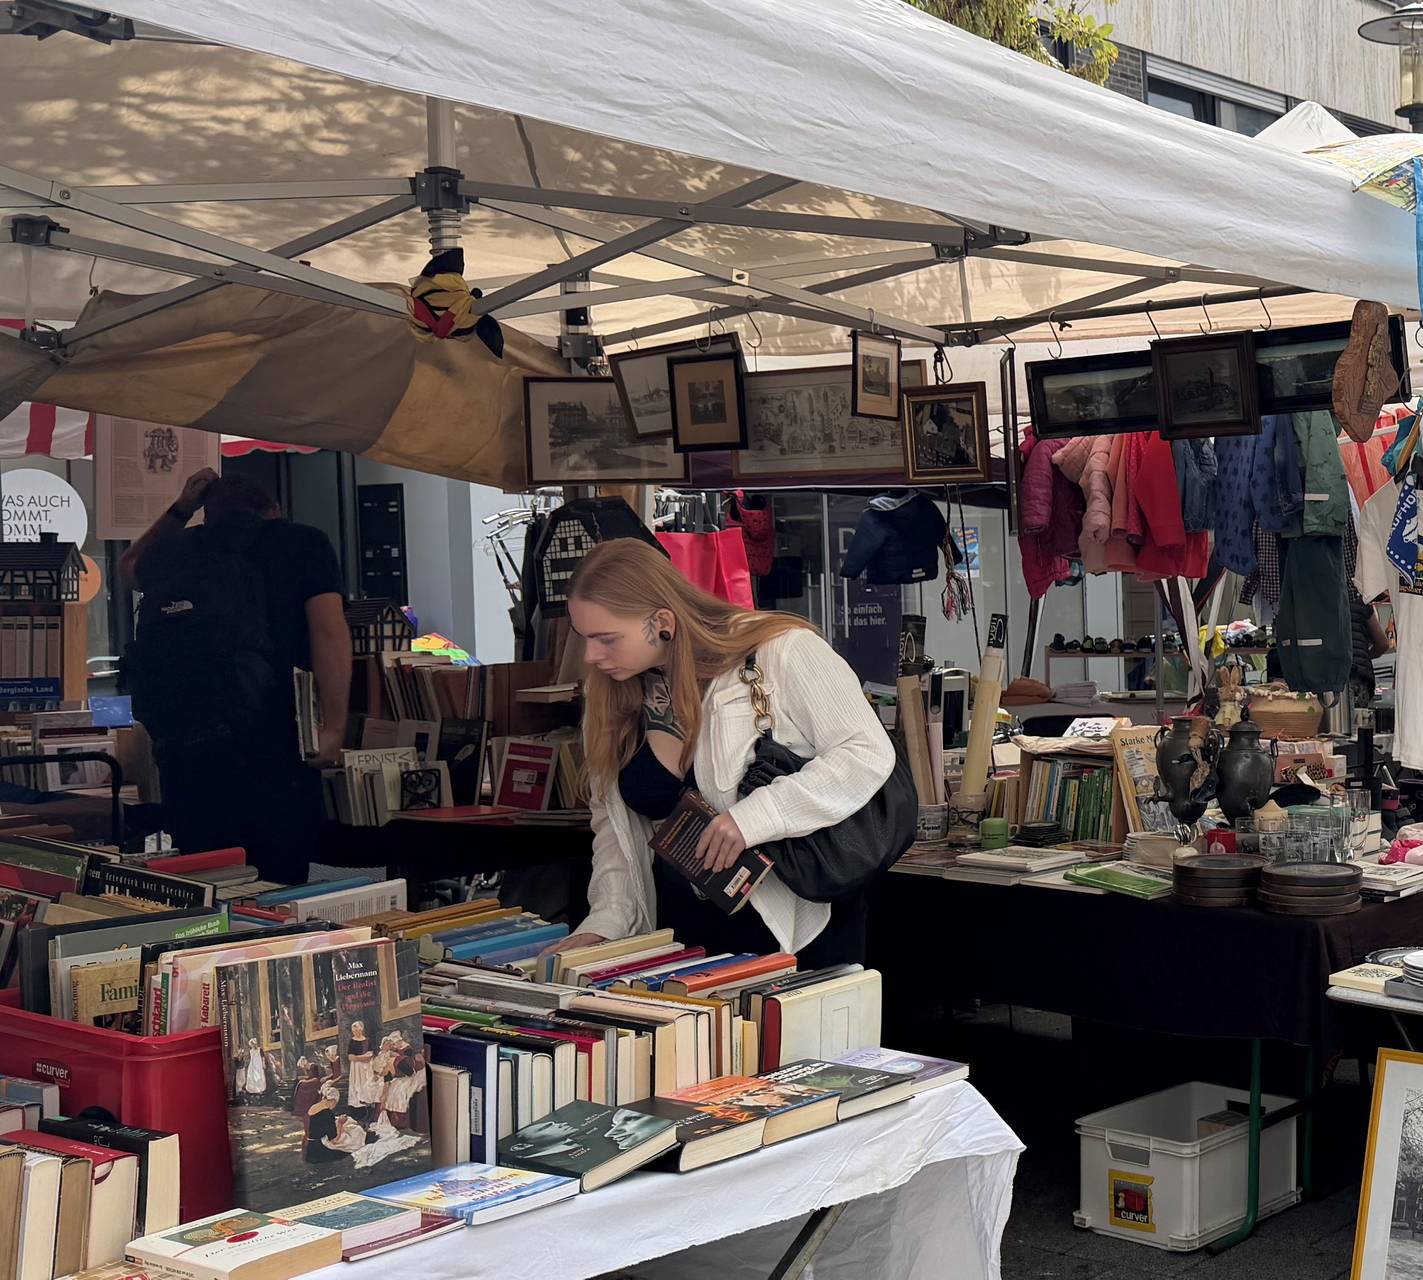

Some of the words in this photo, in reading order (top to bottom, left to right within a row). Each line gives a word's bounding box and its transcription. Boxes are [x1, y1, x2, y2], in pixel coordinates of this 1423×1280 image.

[27, 495, 71, 508] AUCH
[2, 509, 52, 523] OMMT,
[853, 603, 882, 615] einfach
[853, 616, 868, 626] das
[869, 615, 887, 625] hier.
[1120, 735, 1145, 746] Starke
[347, 961, 364, 970] Max
[335, 970, 378, 982] Liebermann
[201, 982, 211, 1023] Kabarett
[42, 1063, 69, 1080] curver
[1121, 1209, 1149, 1223] curver
